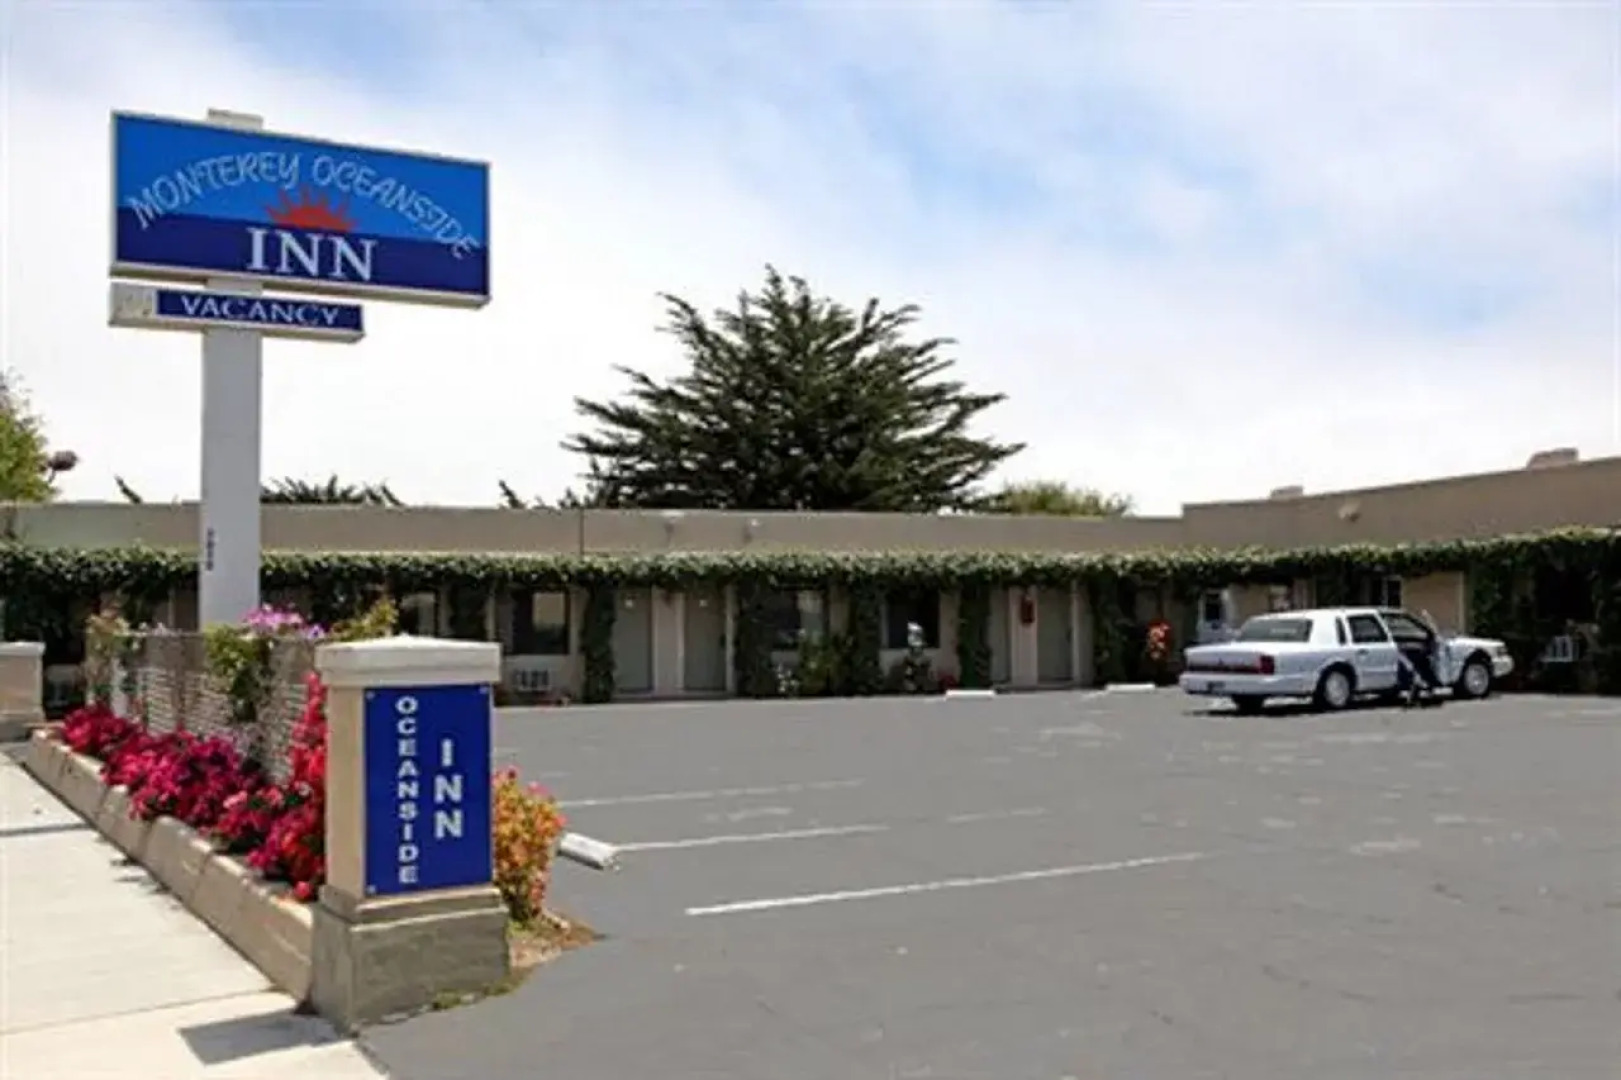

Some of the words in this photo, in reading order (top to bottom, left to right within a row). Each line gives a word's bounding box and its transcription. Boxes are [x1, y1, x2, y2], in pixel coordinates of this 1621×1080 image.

[127, 151, 300, 230] MONTEREY
[312, 155, 480, 260] OCEANSIDE
[246, 227, 378, 281] INN
[181, 295, 339, 326] VACANCY
[395, 696, 419, 884] OCEANSIDE
[434, 738, 463, 840] INN
